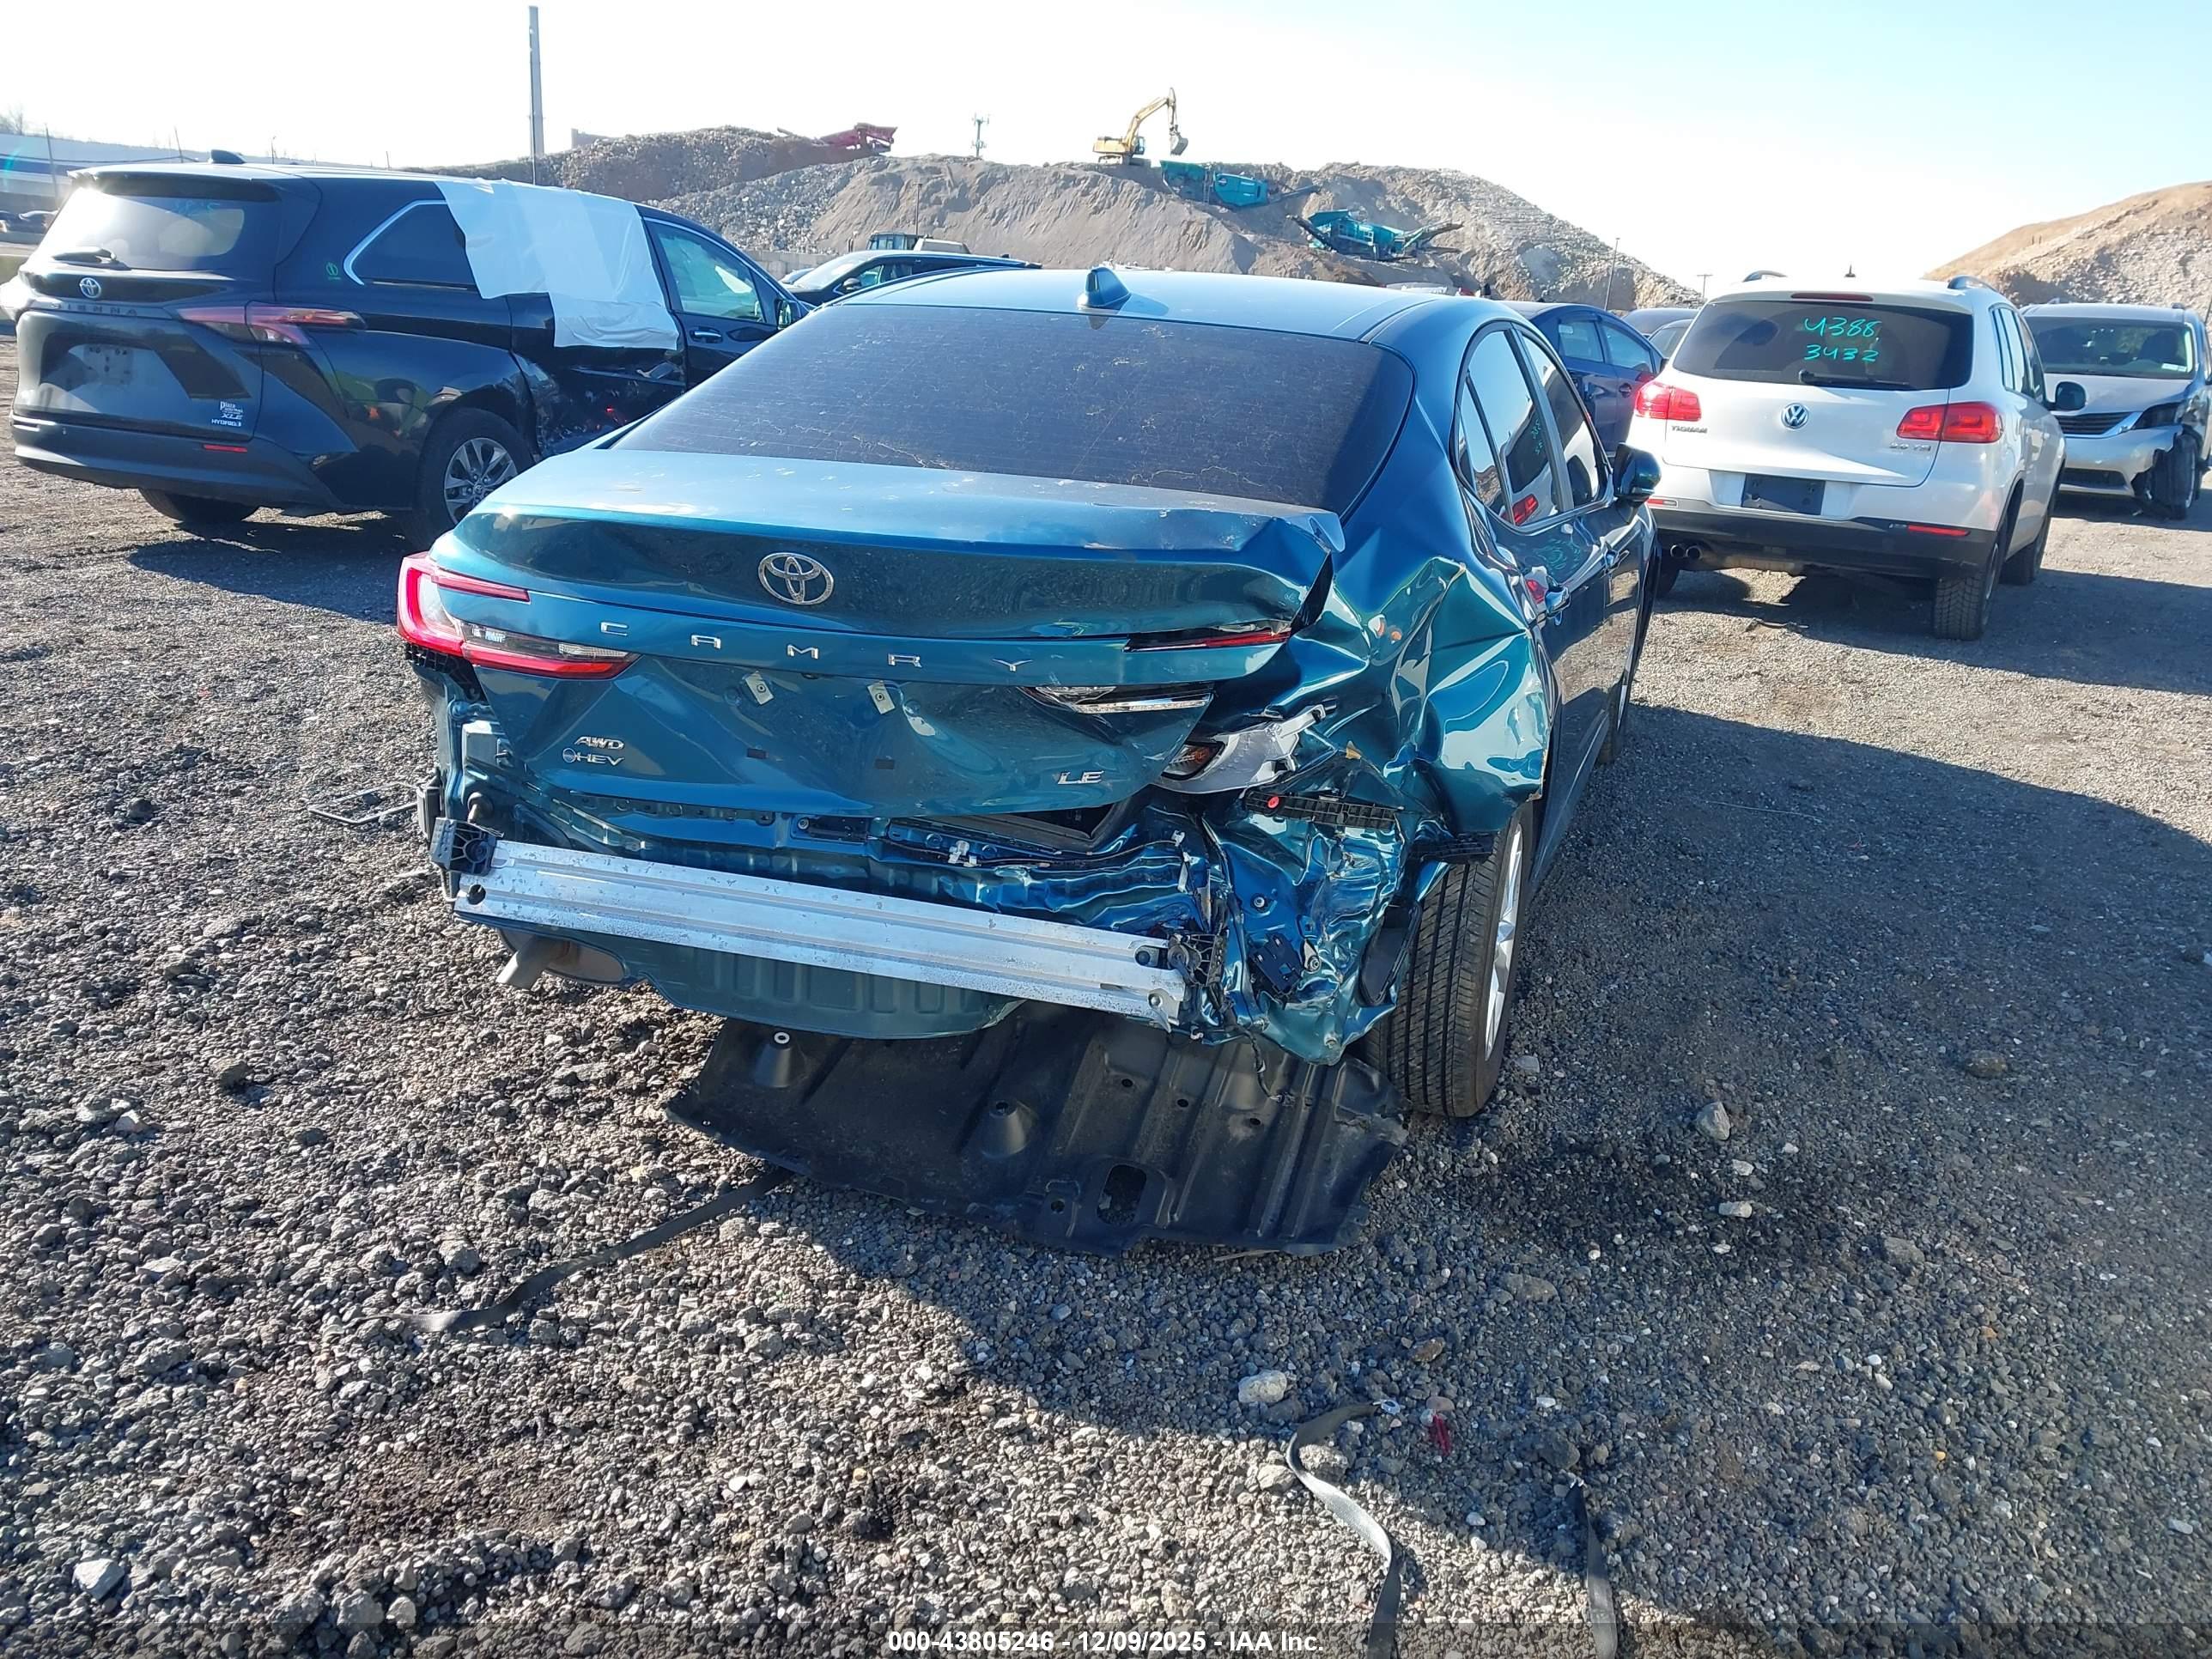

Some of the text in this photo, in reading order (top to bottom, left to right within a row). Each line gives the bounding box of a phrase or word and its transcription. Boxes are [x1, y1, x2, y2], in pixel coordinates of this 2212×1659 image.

[1804, 317, 1882, 337] 4388
[1804, 344, 1880, 362] 3432
[600, 621, 1033, 672] CAMRY
[574, 736, 624, 750] AWD
[1057, 770, 1105, 785] LE
